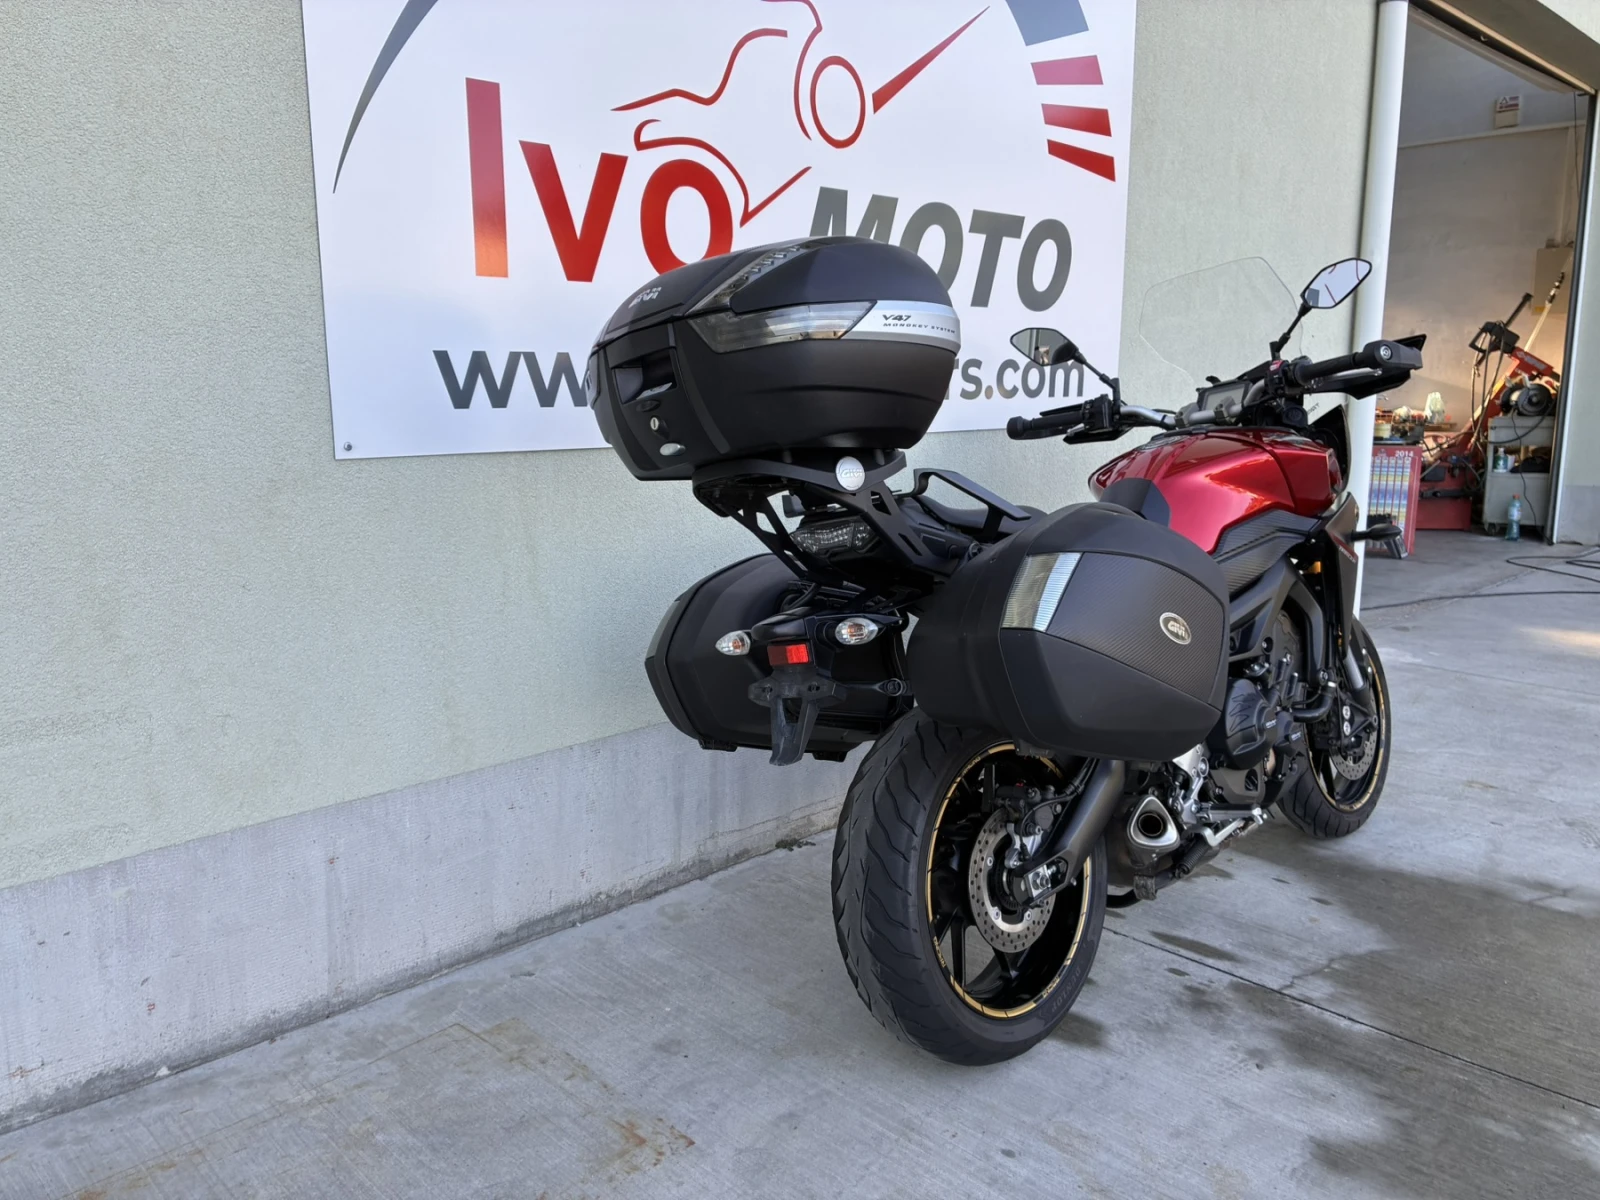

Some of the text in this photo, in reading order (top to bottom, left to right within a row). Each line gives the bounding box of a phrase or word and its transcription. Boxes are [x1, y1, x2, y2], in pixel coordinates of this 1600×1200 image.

[882, 314, 911, 322] V47
[931, 325, 956, 334] SYSTEM
[1395, 449, 1414, 458] 2014
